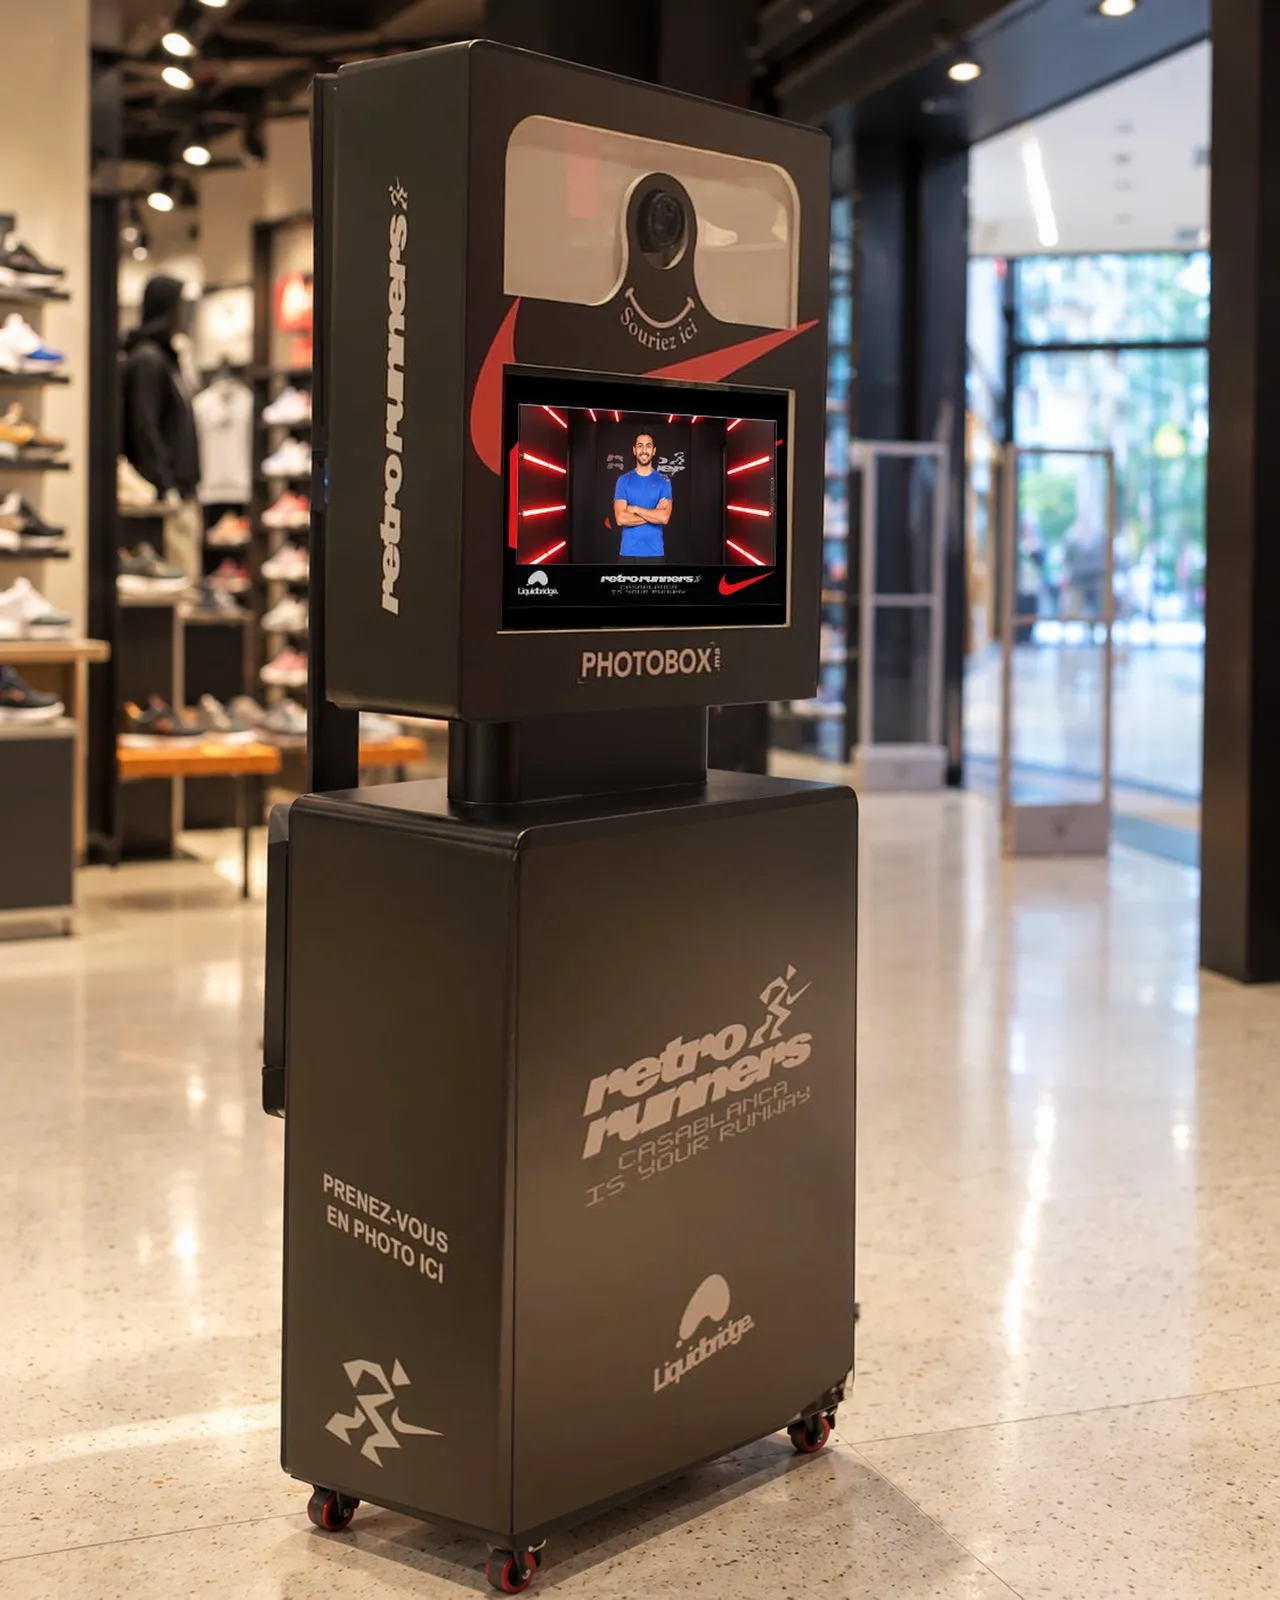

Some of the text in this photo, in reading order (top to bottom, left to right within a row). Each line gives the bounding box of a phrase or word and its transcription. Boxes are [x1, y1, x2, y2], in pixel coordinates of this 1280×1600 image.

[620, 306, 698, 351] Souriez ici
[581, 648, 712, 678] PHOTOBOX
[582, 1032, 813, 1160] runners
[583, 1023, 748, 1117] retro
[586, 1085, 812, 1208] IS YOUR RUNWAY
[618, 1080, 789, 1171] CASABLANCA
[323, 1172, 449, 1254] PRENEZ-VOUS
[326, 1204, 444, 1284] EN PHOTO ICI
